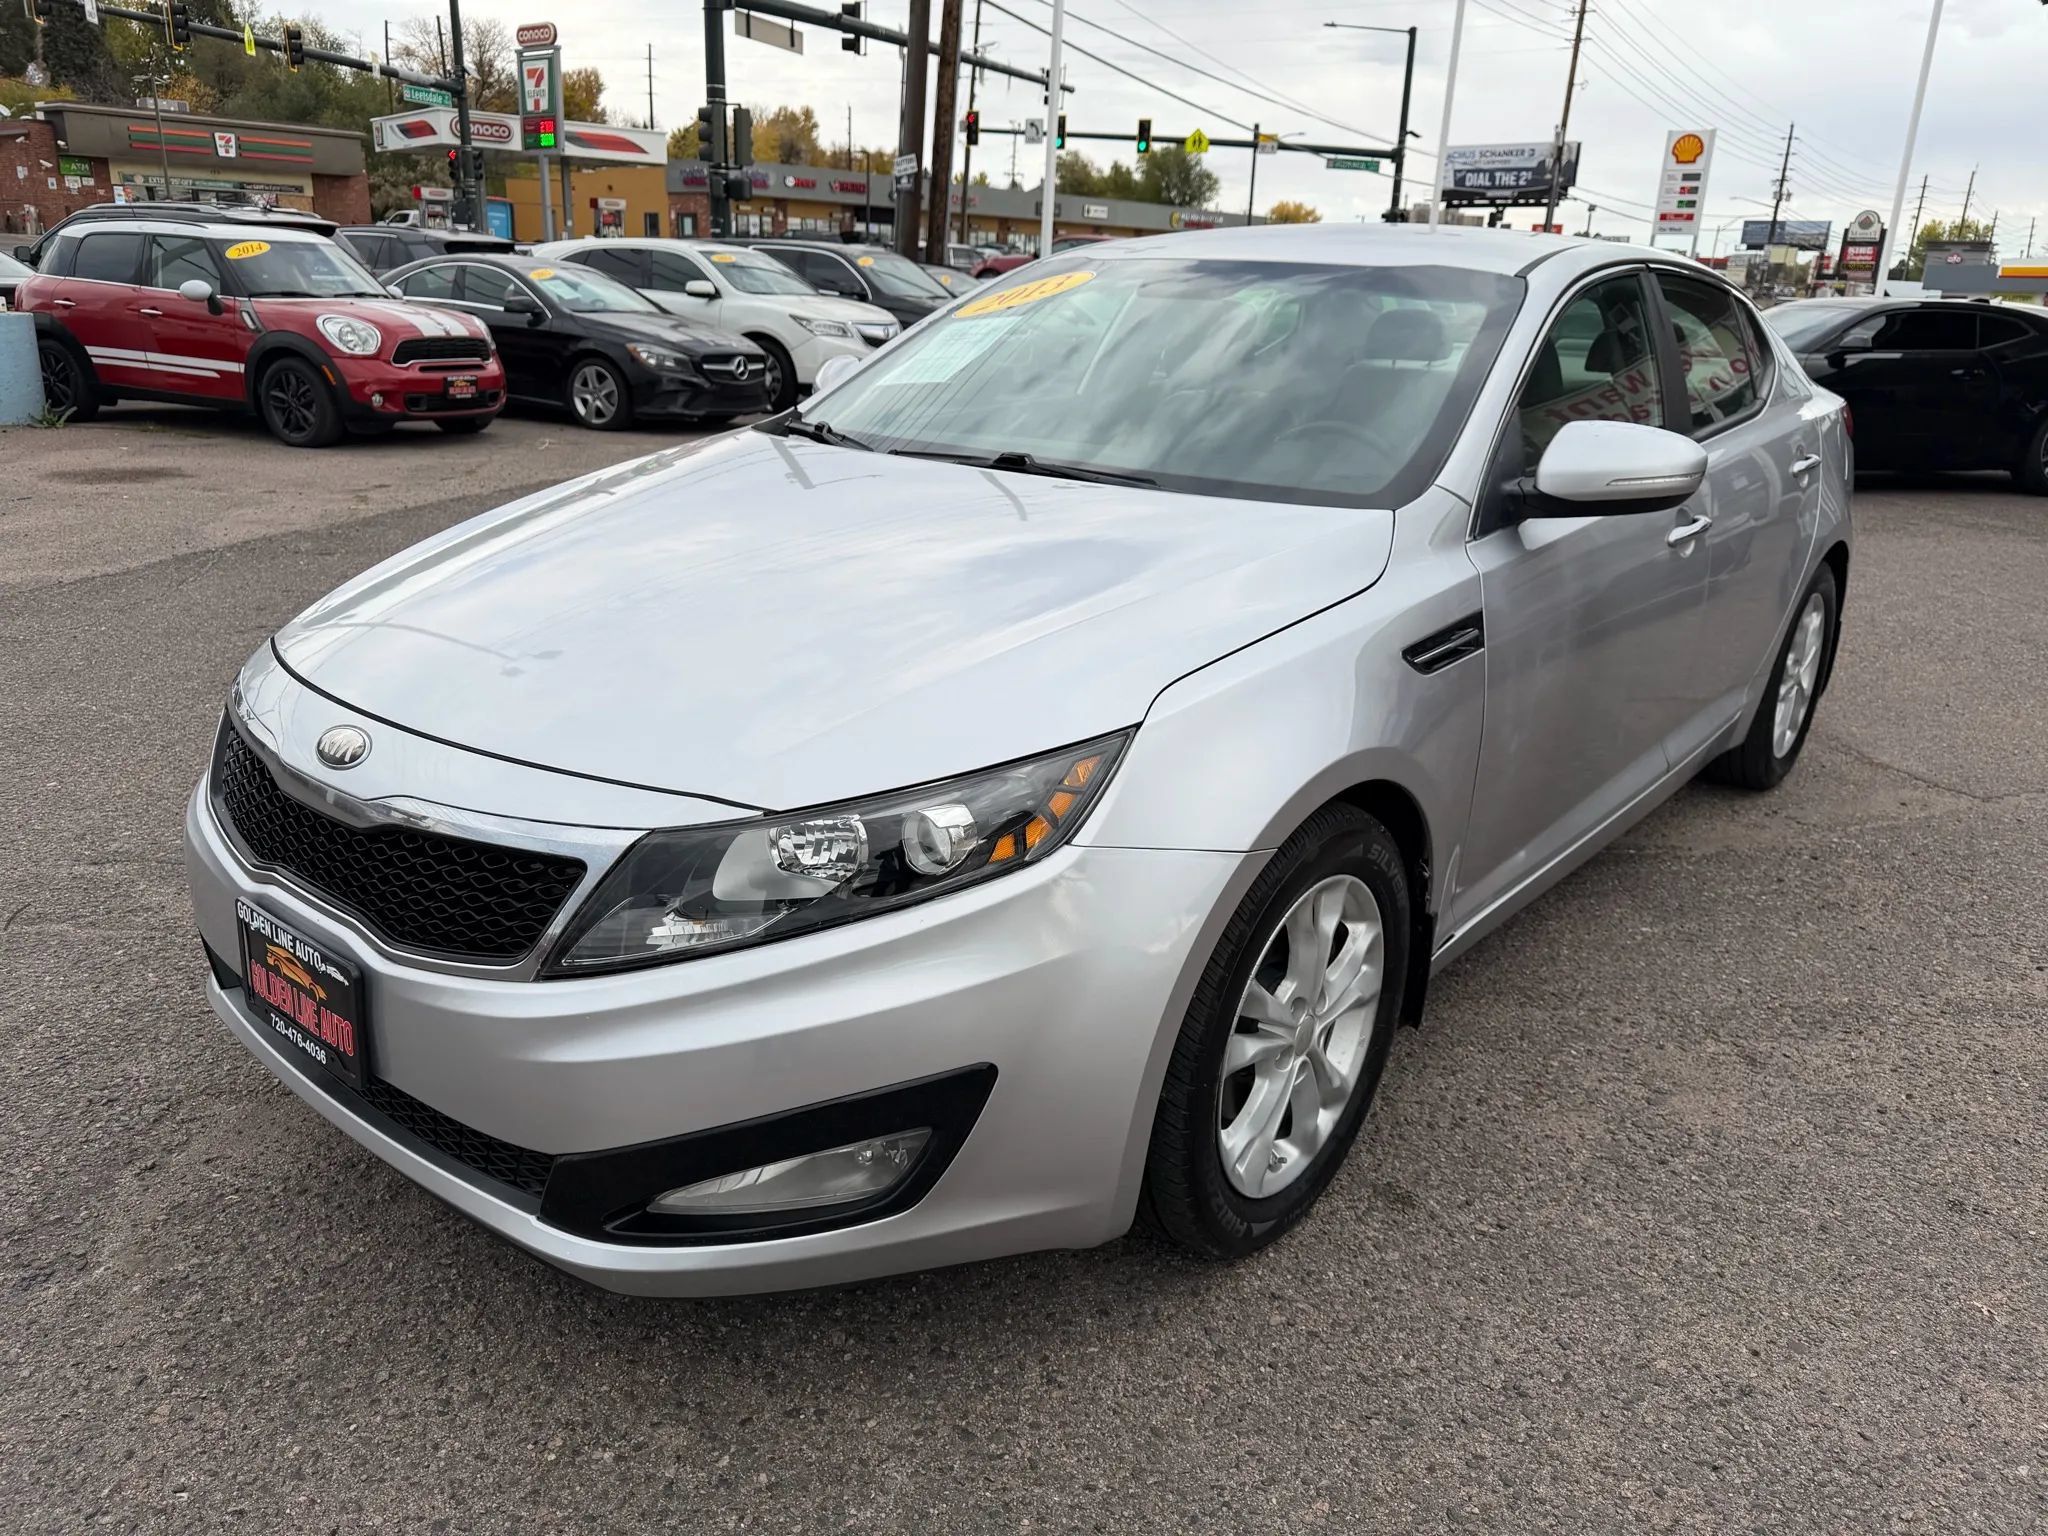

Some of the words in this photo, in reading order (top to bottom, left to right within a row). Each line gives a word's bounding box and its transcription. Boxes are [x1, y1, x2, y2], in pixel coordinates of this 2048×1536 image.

[70, 162, 90, 171] ATM
[1464, 171, 1493, 187] DIAL
[1494, 170, 1518, 186] THE
[235, 242, 263, 257] 2014
[973, 274, 1074, 311] 2013
[237, 902, 272, 939] GOLDEN
[272, 925, 294, 954] LINE
[295, 942, 321, 970] AUTO
[251, 959, 292, 1018] GOLDEN
[293, 987, 320, 1037] LINE
[320, 1007, 354, 1057] AUTO
[270, 1013, 327, 1065] 720-476-4036
